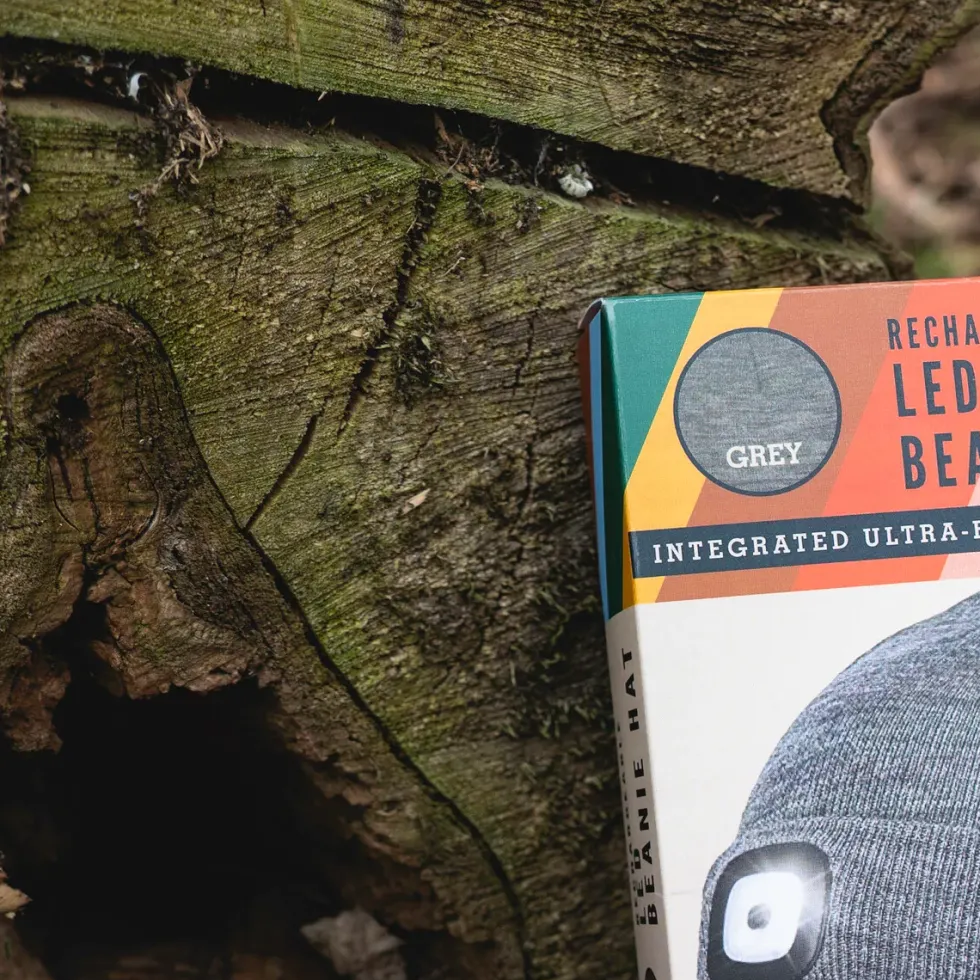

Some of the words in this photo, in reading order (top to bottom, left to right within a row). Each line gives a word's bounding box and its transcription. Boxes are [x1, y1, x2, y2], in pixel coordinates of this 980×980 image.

[893, 359, 978, 418] LED
[726, 441, 802, 472] GREY
[652, 530, 849, 565] INTEGRATED
[621, 647, 641, 732] HAT
[633, 758, 659, 926] BEANIE
